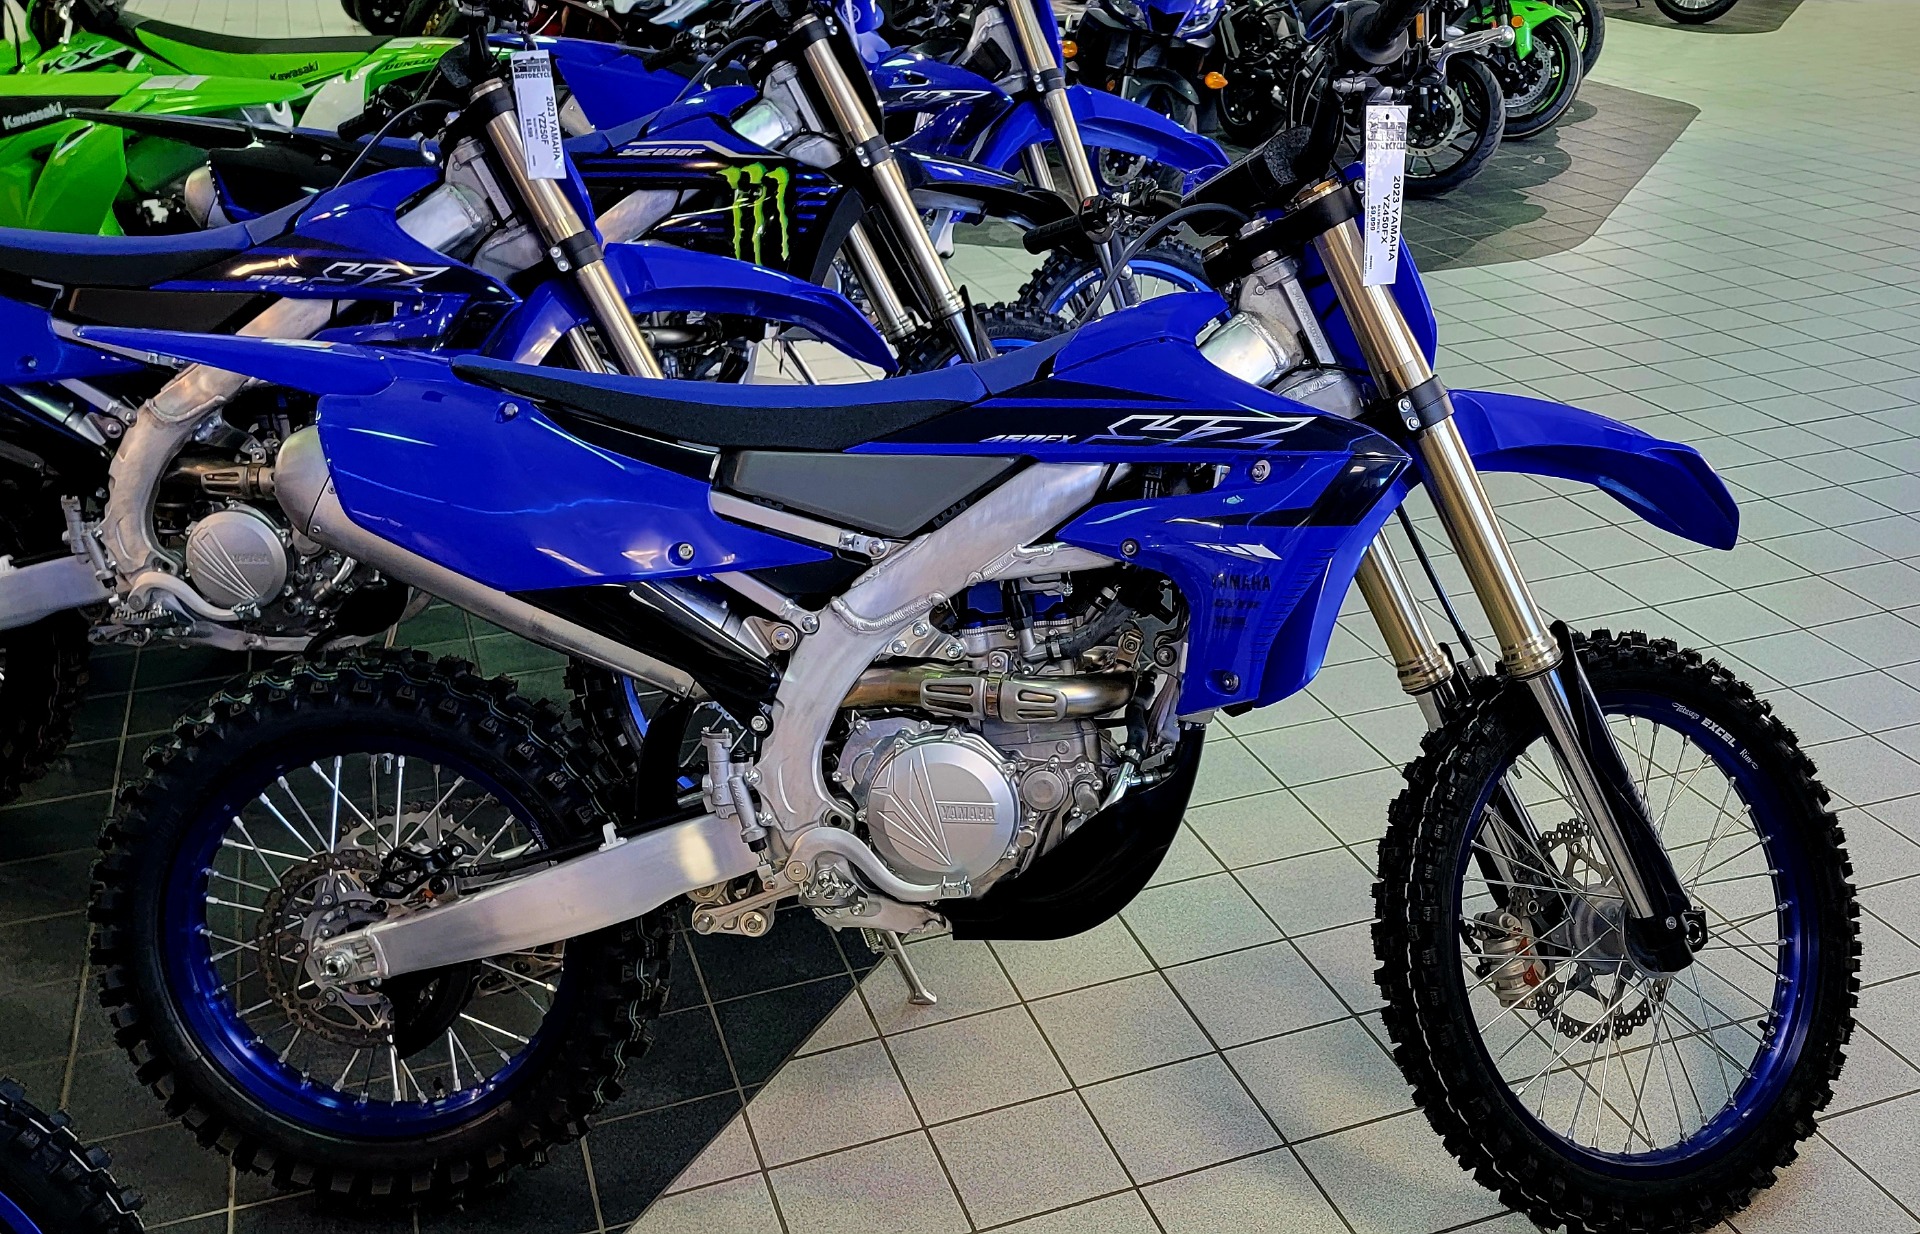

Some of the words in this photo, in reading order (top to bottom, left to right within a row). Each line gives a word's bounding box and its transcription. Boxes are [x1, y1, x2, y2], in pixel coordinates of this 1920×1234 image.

[269, 61, 319, 81] Kawasaki
[3, 101, 63, 130] Kawasaki
[545, 96, 556, 117] 2023
[538, 112, 550, 145] YZ250F
[549, 121, 561, 161] YAMAHA
[1392, 175, 1401, 204] 2023
[1380, 194, 1391, 244] YZ450FX
[1388, 207, 1399, 262] YAMAHA
[979, 434, 1076, 444] 450FX
[1211, 573, 1271, 592] YAMAHA
[1701, 717, 1736, 748] EXCEL
[940, 805, 995, 821] YAMAHA
